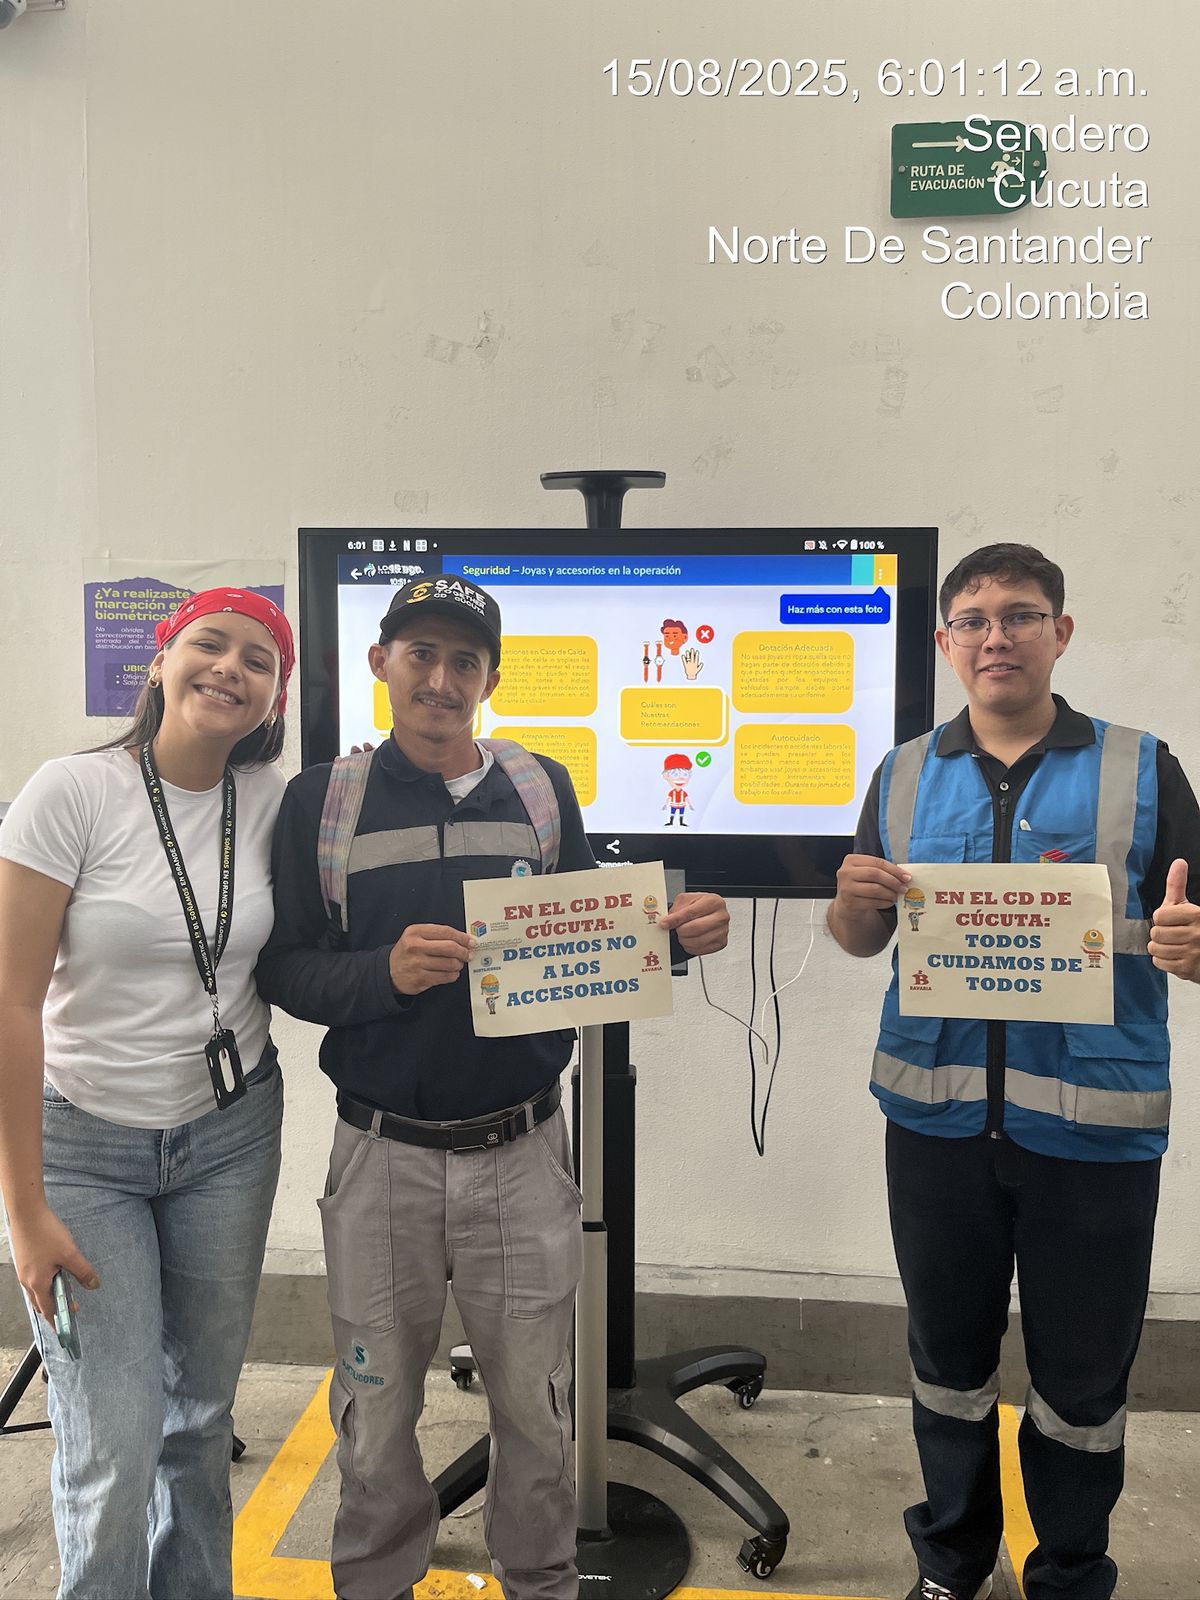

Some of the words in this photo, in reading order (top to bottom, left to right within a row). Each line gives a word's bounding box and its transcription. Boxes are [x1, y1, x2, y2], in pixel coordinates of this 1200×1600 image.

[910, 165, 945, 179] RUTA
[947, 164, 965, 177] DE
[910, 176, 985, 192] EVACUACIÓN
[347, 541, 366, 550] 6:01
[859, 541, 875, 549] 100
[876, 541, 885, 549] %
[463, 566, 511, 577] Seguridad
[520, 566, 546, 577] Joyas
[548, 568, 554, 576] y
[556, 566, 606, 575] accesorios
[622, 566, 631, 575] la
[633, 565, 681, 576] operación
[94, 587, 120, 600] ¿Ya
[123, 588, 190, 599] realizaste
[434, 579, 486, 603] SAFE
[436, 589, 487, 609] TOGETHER
[95, 599, 166, 610] marcación
[788, 604, 804, 614] Haz
[806, 604, 824, 614] más
[826, 606, 842, 614] con
[844, 604, 863, 614] esta
[865, 604, 883, 614] foto
[771, 734, 820, 742] Autocuidado
[223, 837, 231, 869] SOÑAMOS
[178, 876, 187, 886] EN
[223, 869, 229, 879] EN
[182, 887, 197, 919] SOÑAMOS
[935, 891, 965, 905] EN
[969, 891, 998, 905] EL
[1002, 891, 1035, 906] CD
[1040, 892, 1072, 906] DE
[504, 904, 533, 921] EN
[538, 901, 566, 917] EL
[570, 897, 600, 914] CD
[604, 893, 633, 910] DE
[955, 909, 1051, 928] CÚCUTA:
[525, 917, 614, 940] CÚCUTA:
[502, 938, 602, 961] DECIMOS
[606, 934, 637, 950] NO
[965, 934, 1042, 949] TODOS
[542, 965, 558, 980] A
[561, 960, 600, 977] LOS
[926, 953, 1045, 972] CUIDAMOS
[1050, 958, 1083, 973] DE
[506, 977, 640, 1007] ACCESORIOS
[965, 976, 1042, 993] TODOS
